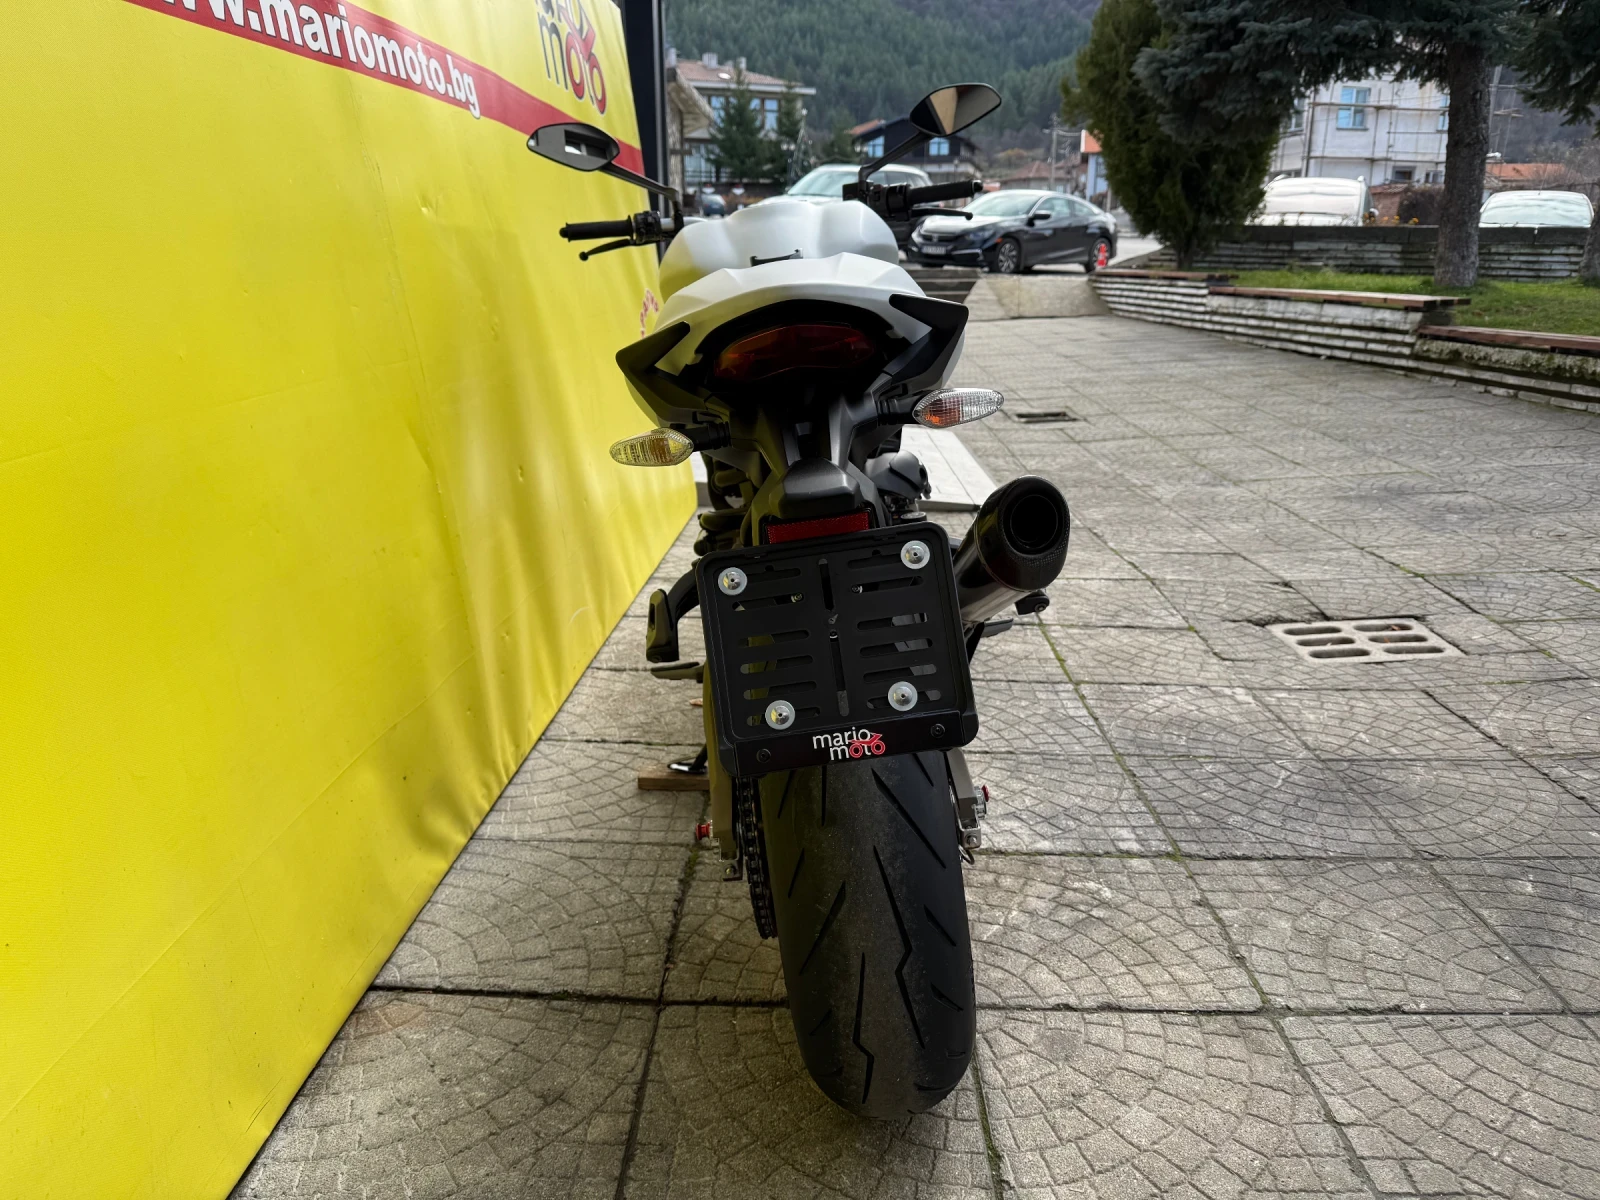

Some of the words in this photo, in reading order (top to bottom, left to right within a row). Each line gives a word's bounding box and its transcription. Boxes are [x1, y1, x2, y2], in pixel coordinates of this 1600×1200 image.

[537, 12, 606, 115] moto
[812, 726, 870, 749] mario
[829, 740, 886, 761] moto
